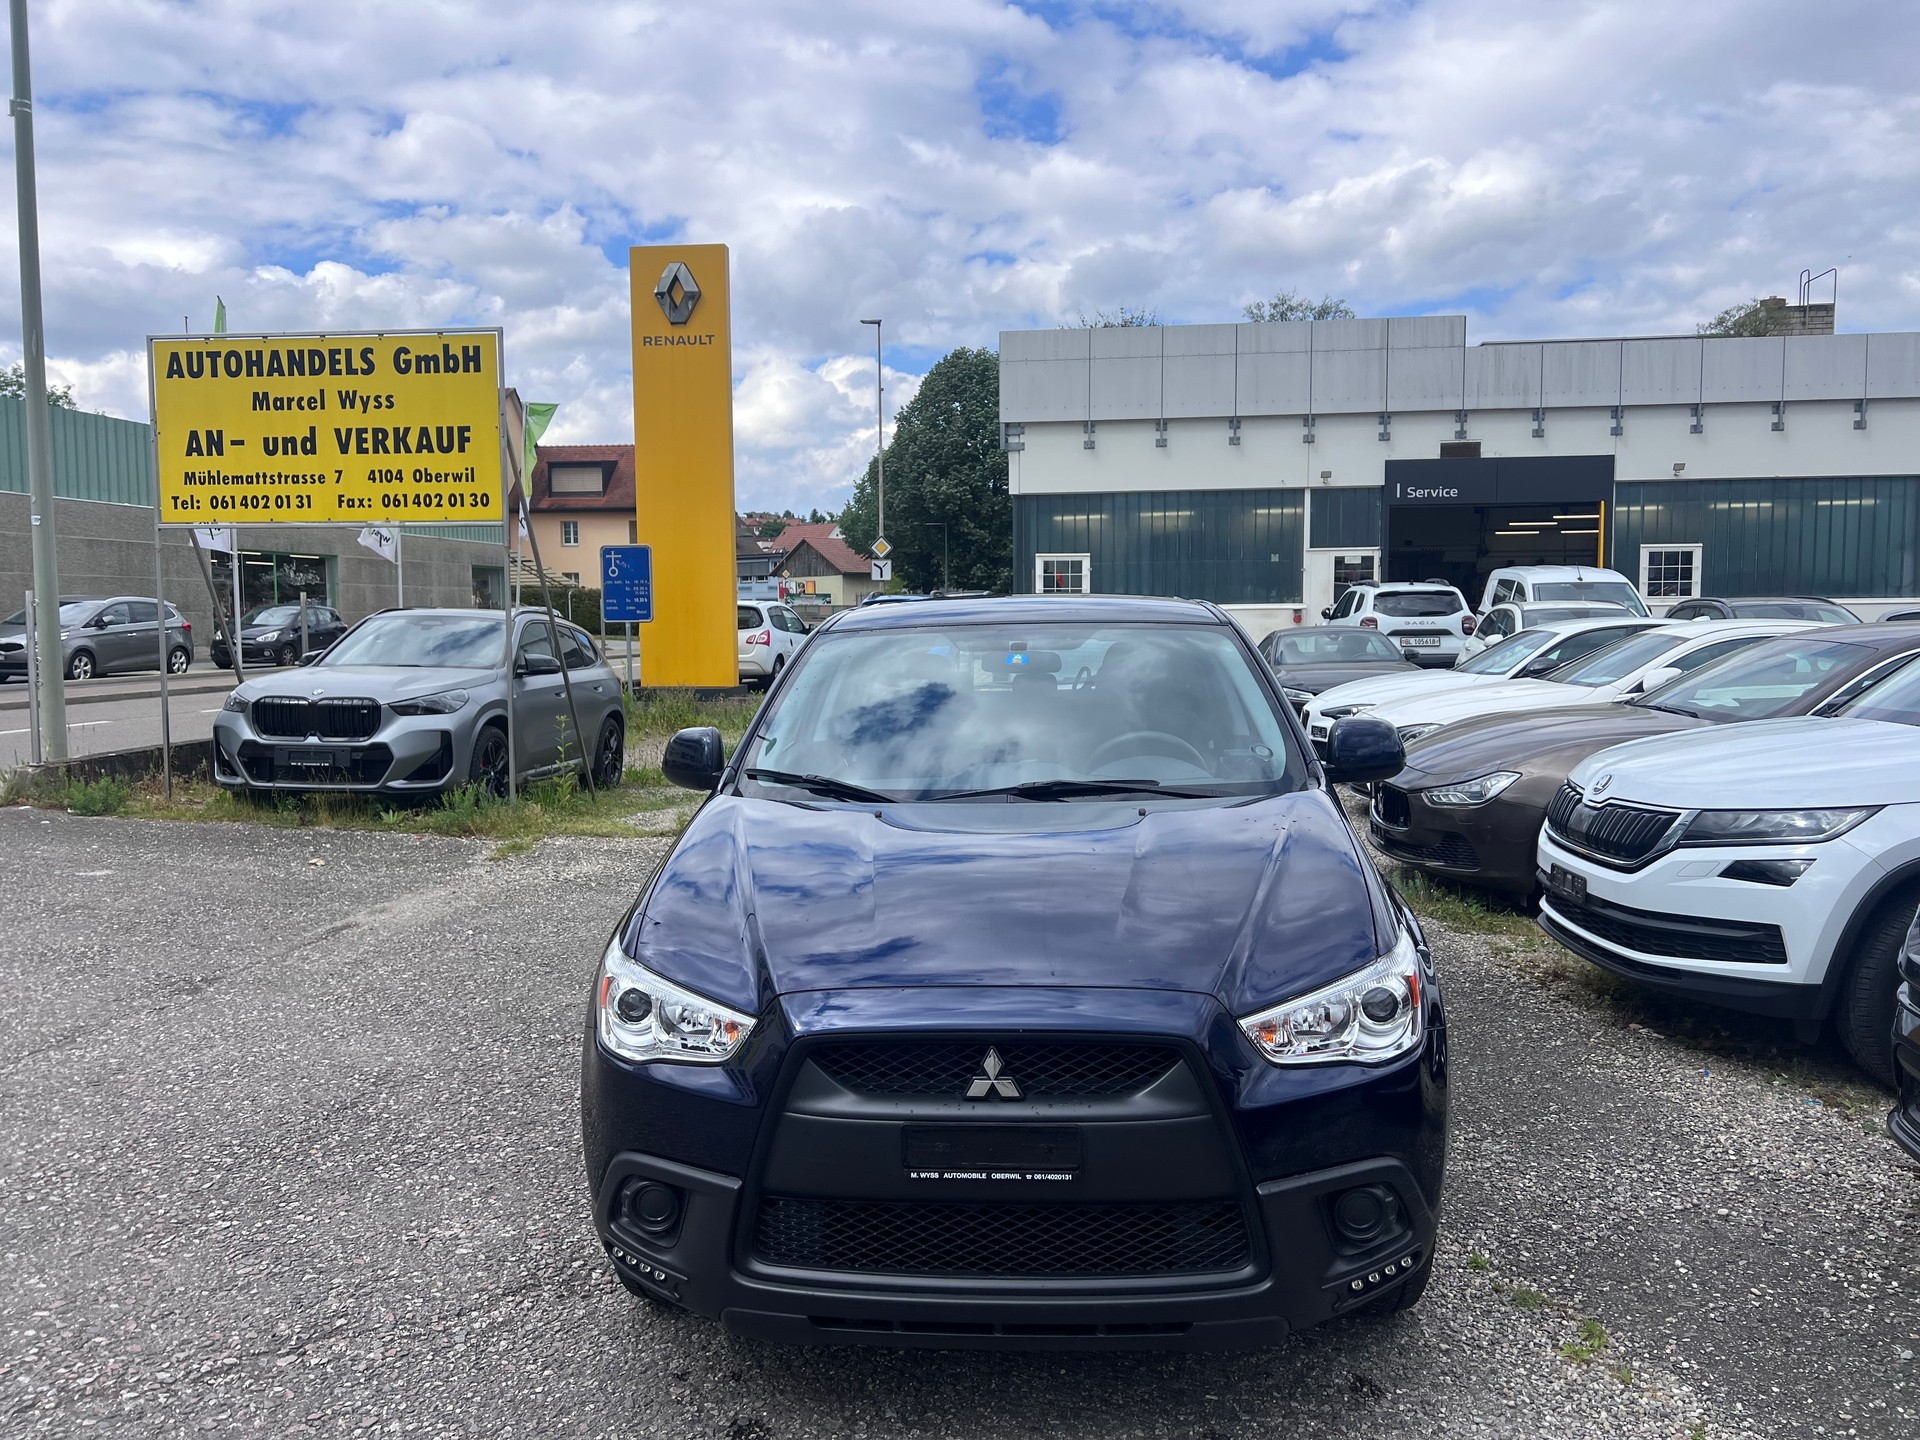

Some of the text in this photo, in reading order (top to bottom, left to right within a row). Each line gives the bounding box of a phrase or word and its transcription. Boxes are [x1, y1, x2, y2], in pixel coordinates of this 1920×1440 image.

[642, 334, 716, 347] RENAULT
[165, 343, 482, 379] AUTOHANDELS GmbH
[252, 388, 395, 414] Marcel Wyss
[262, 425, 317, 457] und
[333, 425, 471, 455] VERKAUF
[183, 466, 475, 486] Mühlemattstrasse 7 4104 Oberwil
[1407, 486, 1458, 498] Service
[171, 494, 201, 511] Tel:
[337, 494, 372, 509] Fax:
[919, 1172, 940, 1180] WYSS
[943, 1172, 987, 1180] AUTOMOBILE
[1033, 1173, 1073, 1181] 061/4020131
